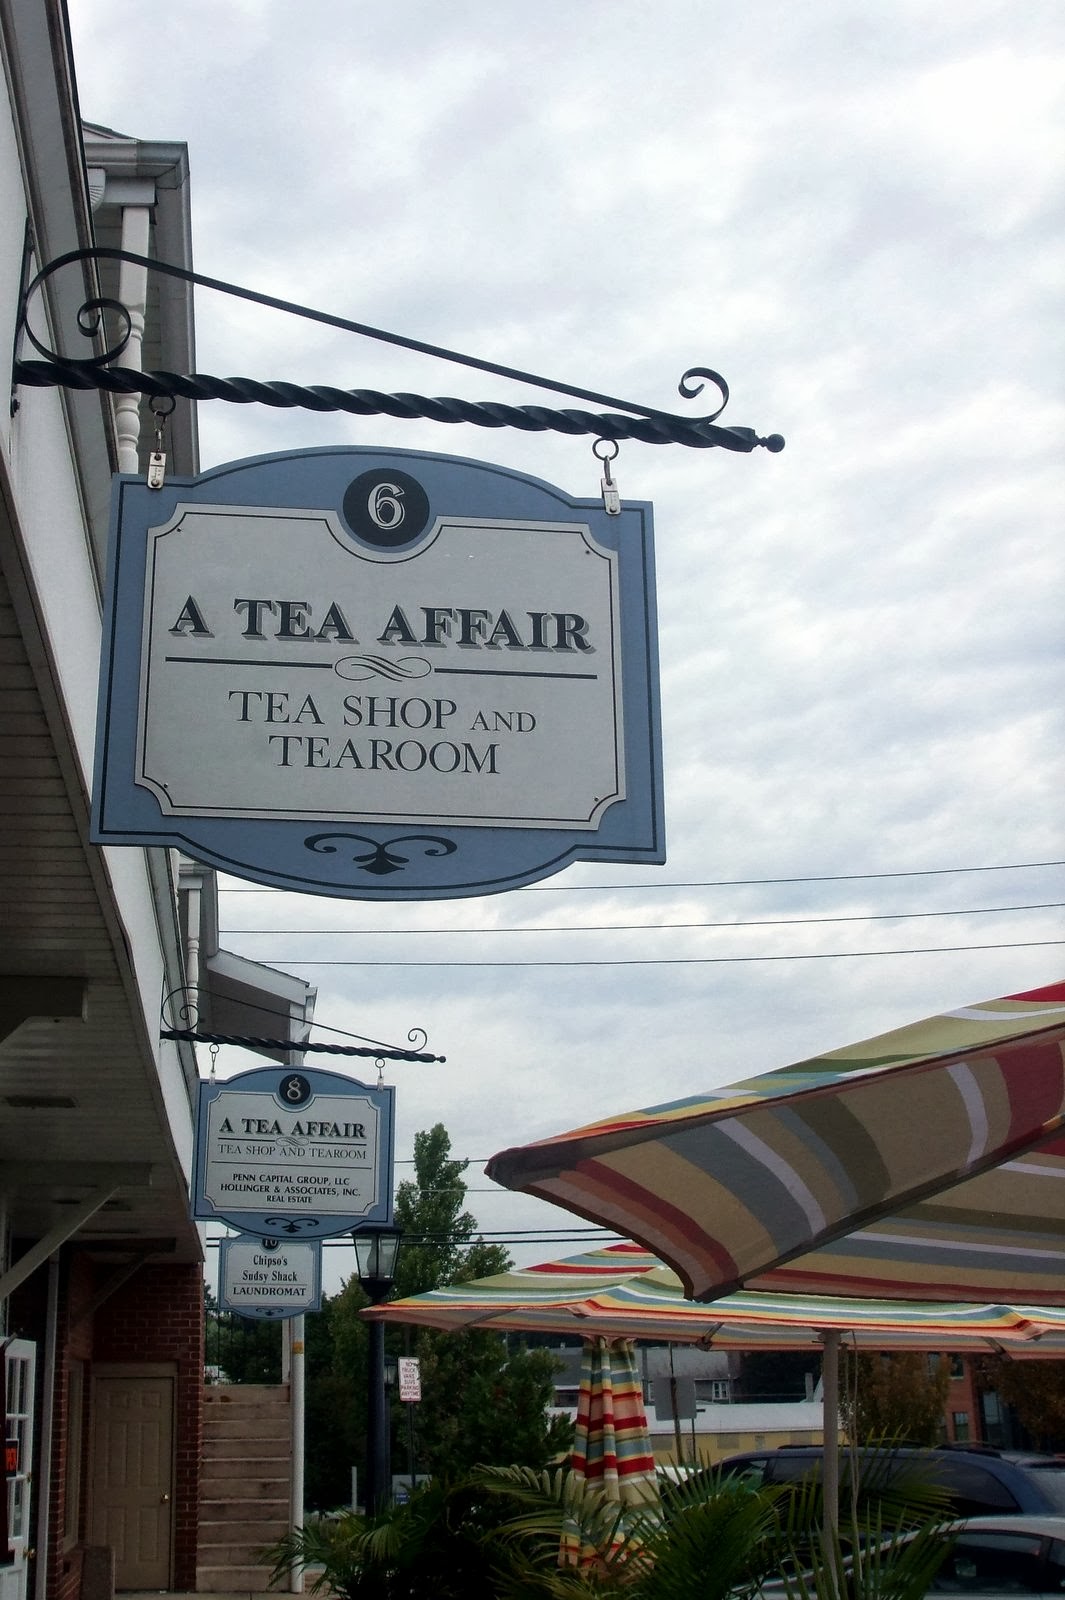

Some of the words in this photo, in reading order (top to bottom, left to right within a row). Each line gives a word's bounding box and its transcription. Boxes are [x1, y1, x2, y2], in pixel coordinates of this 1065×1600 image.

[367, 482, 405, 530] 6
[168, 594, 216, 639] A
[233, 597, 360, 643] TEA
[376, 603, 597, 654] AFFAIR
[229, 690, 326, 726] TEA
[342, 694, 458, 731] SHOP
[470, 710, 537, 733] AND
[268, 735, 501, 776] TEAROOM
[286, 1077, 301, 1100] 8
[219, 1117, 234, 1134] A
[242, 1118, 282, 1135] TEA
[291, 1120, 366, 1139] AFFAIR
[218, 1144, 242, 1155] TEA
[246, 1145, 275, 1156] SHOP
[279, 1146, 305, 1157] AND
[309, 1147, 367, 1160] TEAROOM
[232, 1173, 256, 1182] PENN
[259, 1174, 293, 1184] CAPITAL
[296, 1175, 331, 1186] GROUP,
[334, 1177, 350, 1186] LLC
[220, 1183, 270, 1193] HOLLINGER
[273, 1185, 280, 1194] &
[284, 1184, 340, 1196] ASSOCIATES,
[342, 1187, 361, 1197] INC.
[266, 1194, 285, 1204] REAL
[287, 1195, 313, 1204] ESTATE
[253, 1254, 288, 1268] Chipso's
[271, 1270, 298, 1282] Shack
[233, 1286, 307, 1296] LAUNDROMAT
